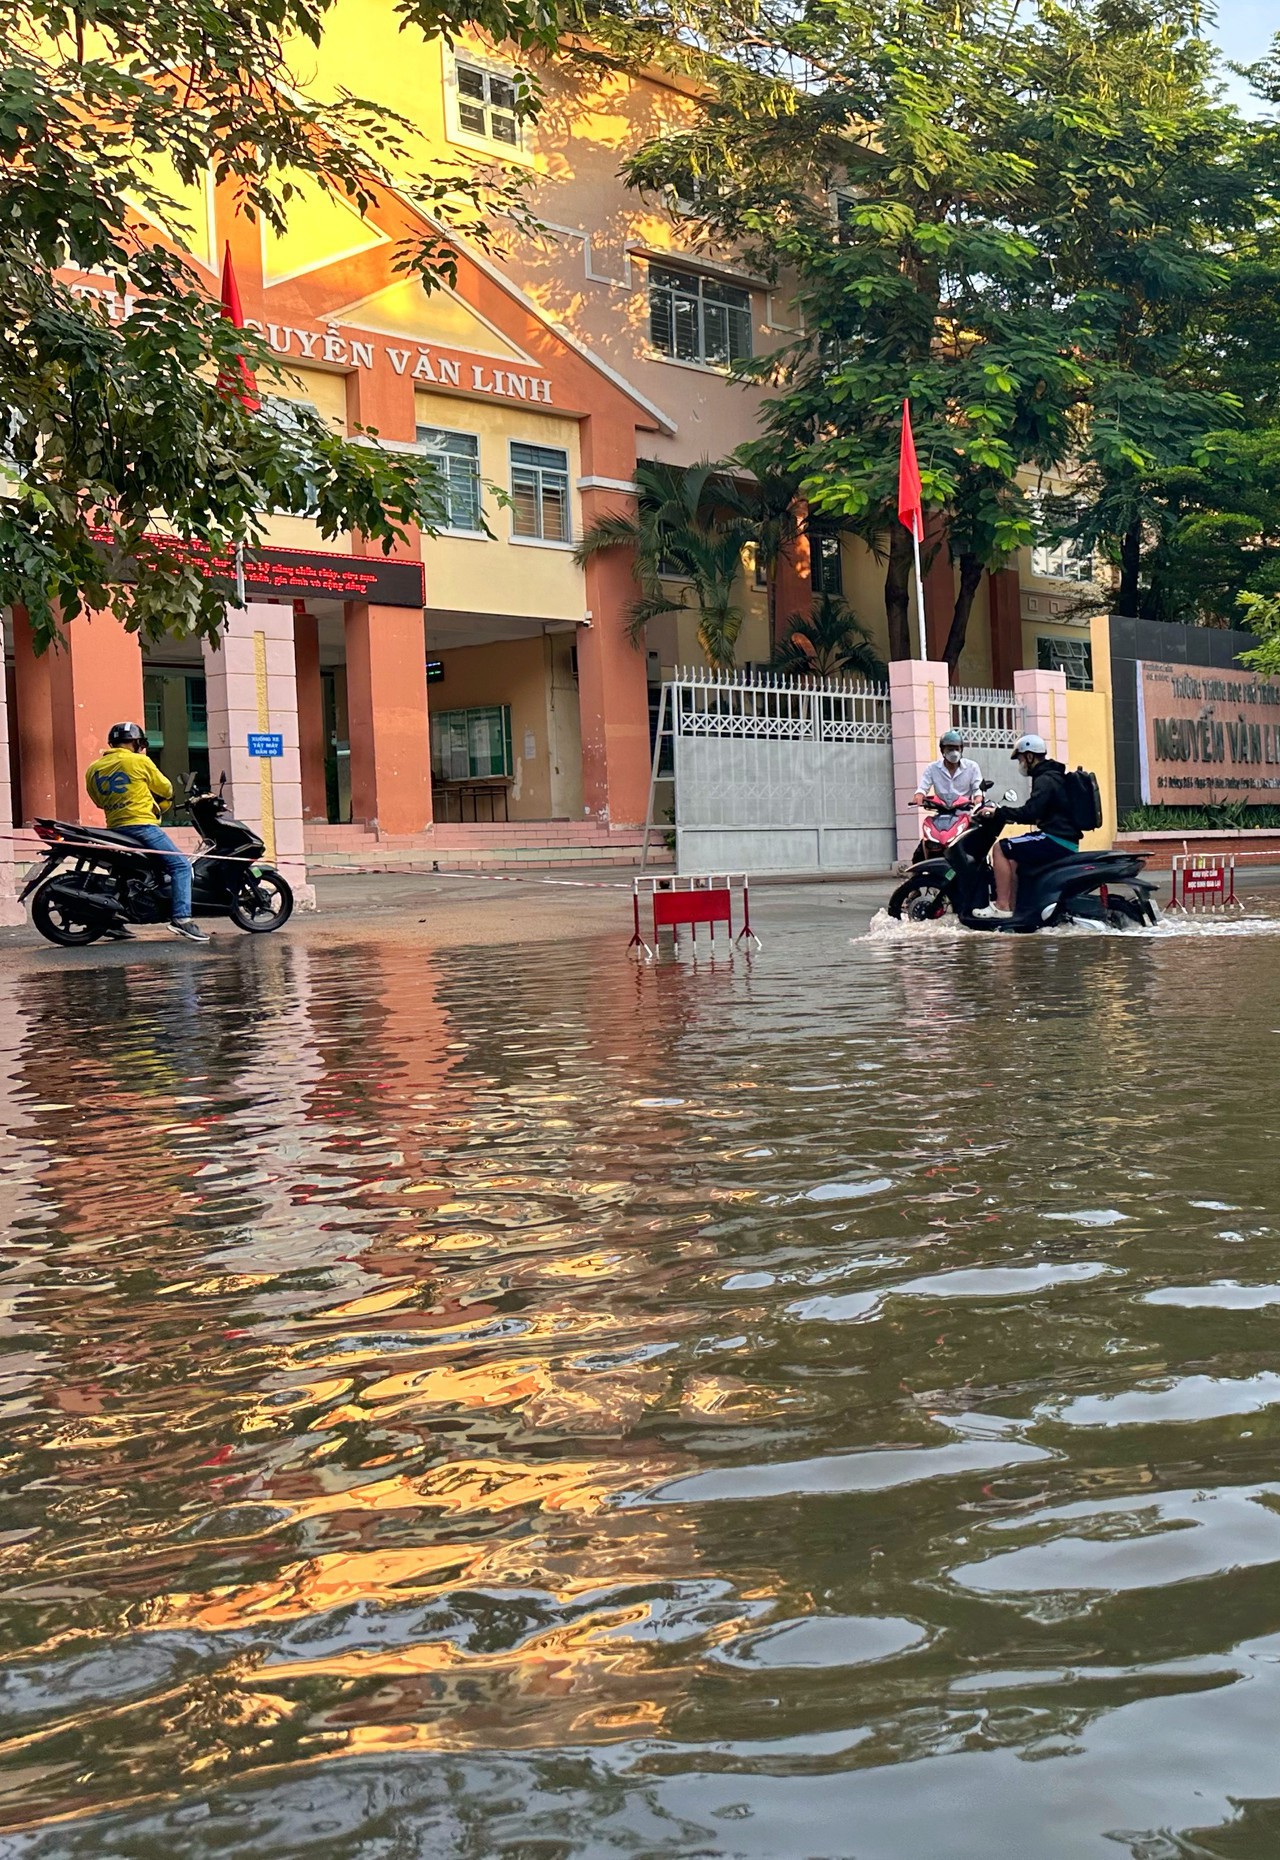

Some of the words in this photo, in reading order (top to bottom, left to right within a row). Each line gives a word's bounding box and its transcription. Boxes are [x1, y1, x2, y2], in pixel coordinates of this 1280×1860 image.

[230, 319, 375, 370] GUYỄN
[385, 346, 461, 387] VĂN
[471, 364, 553, 404] LINH
[94, 770, 131, 795] be
